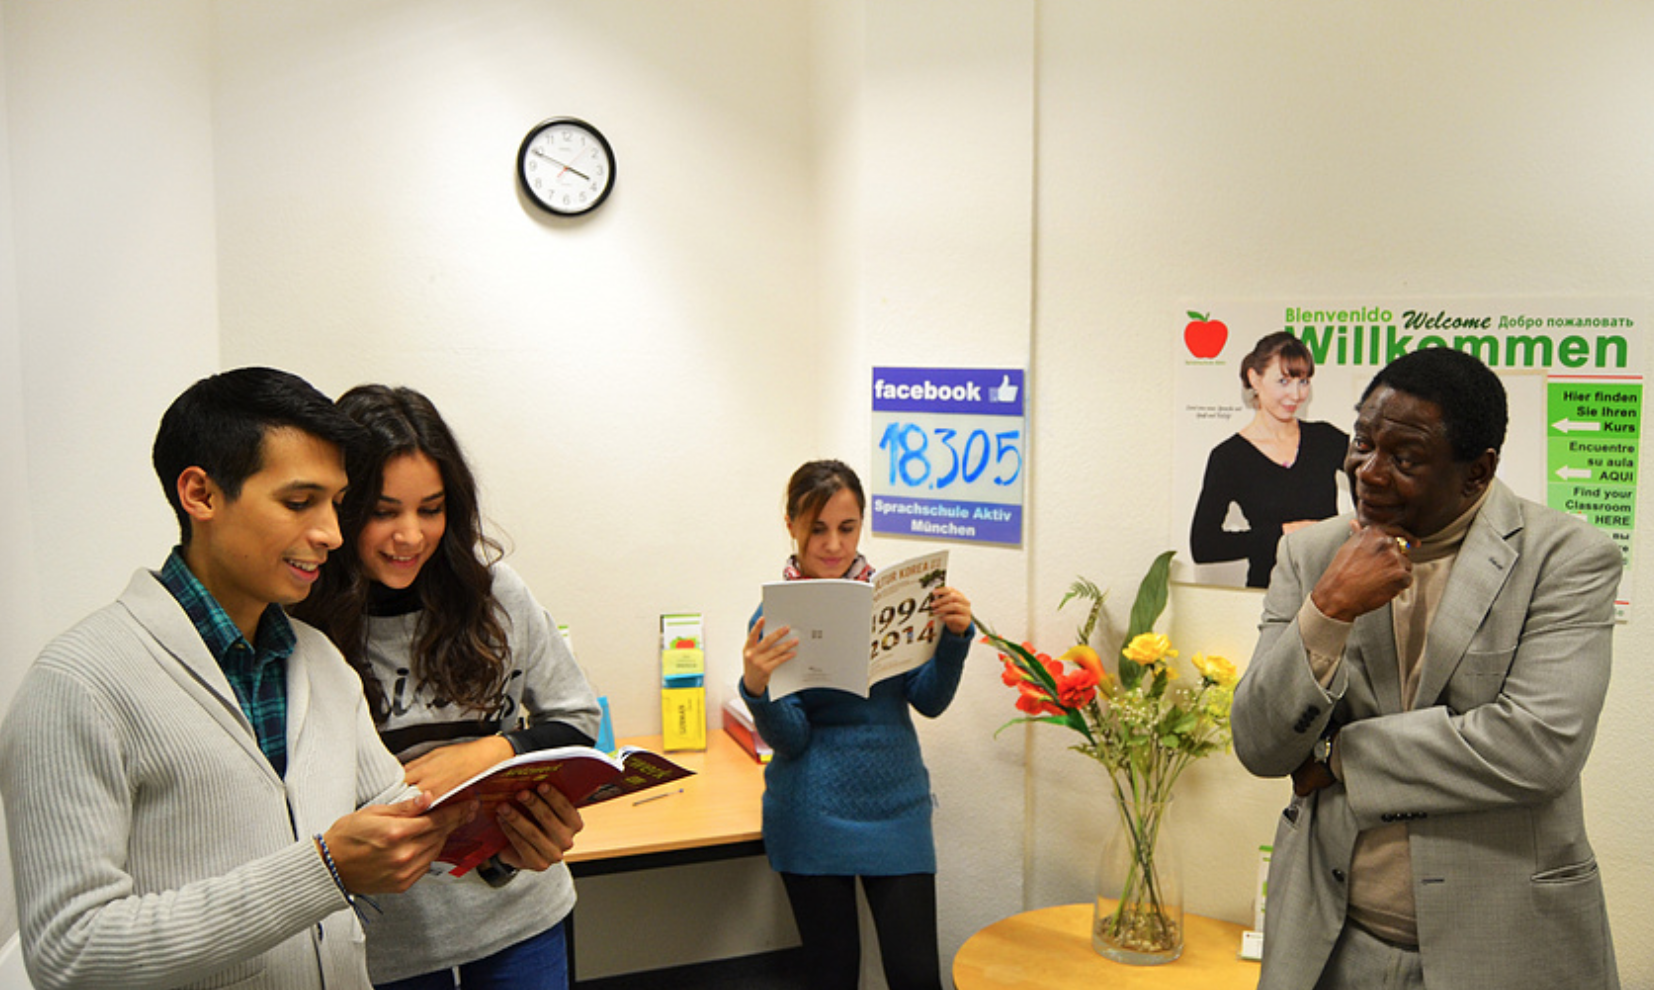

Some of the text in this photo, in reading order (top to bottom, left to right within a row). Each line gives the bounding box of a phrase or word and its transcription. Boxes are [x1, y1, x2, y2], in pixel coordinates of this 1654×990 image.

[562, 131, 572, 142] 12
[591, 148, 598, 158] 2
[529, 161, 536, 171] 9
[1285, 307, 1392, 323] Bienvenido
[1402, 310, 1491, 330] Welcome
[1498, 315, 1634, 330] Добро пожаловать
[874, 379, 981, 401] facebook
[1563, 391, 1637, 403] Hier finden
[1577, 406, 1637, 418] Sie Ihren
[1604, 422, 1635, 433] Kurs
[1569, 441, 1635, 453] Encuentre
[1588, 458, 1634, 468] su aula
[1599, 471, 1634, 482] AQUI
[1573, 487, 1633, 501] Find your
[874, 499, 1012, 522] Sprachschule Aktiv
[1565, 500, 1632, 513] Classroom
[1595, 516, 1631, 527] HERE
[910, 519, 976, 537] München
[870, 620, 936, 660] 2014
